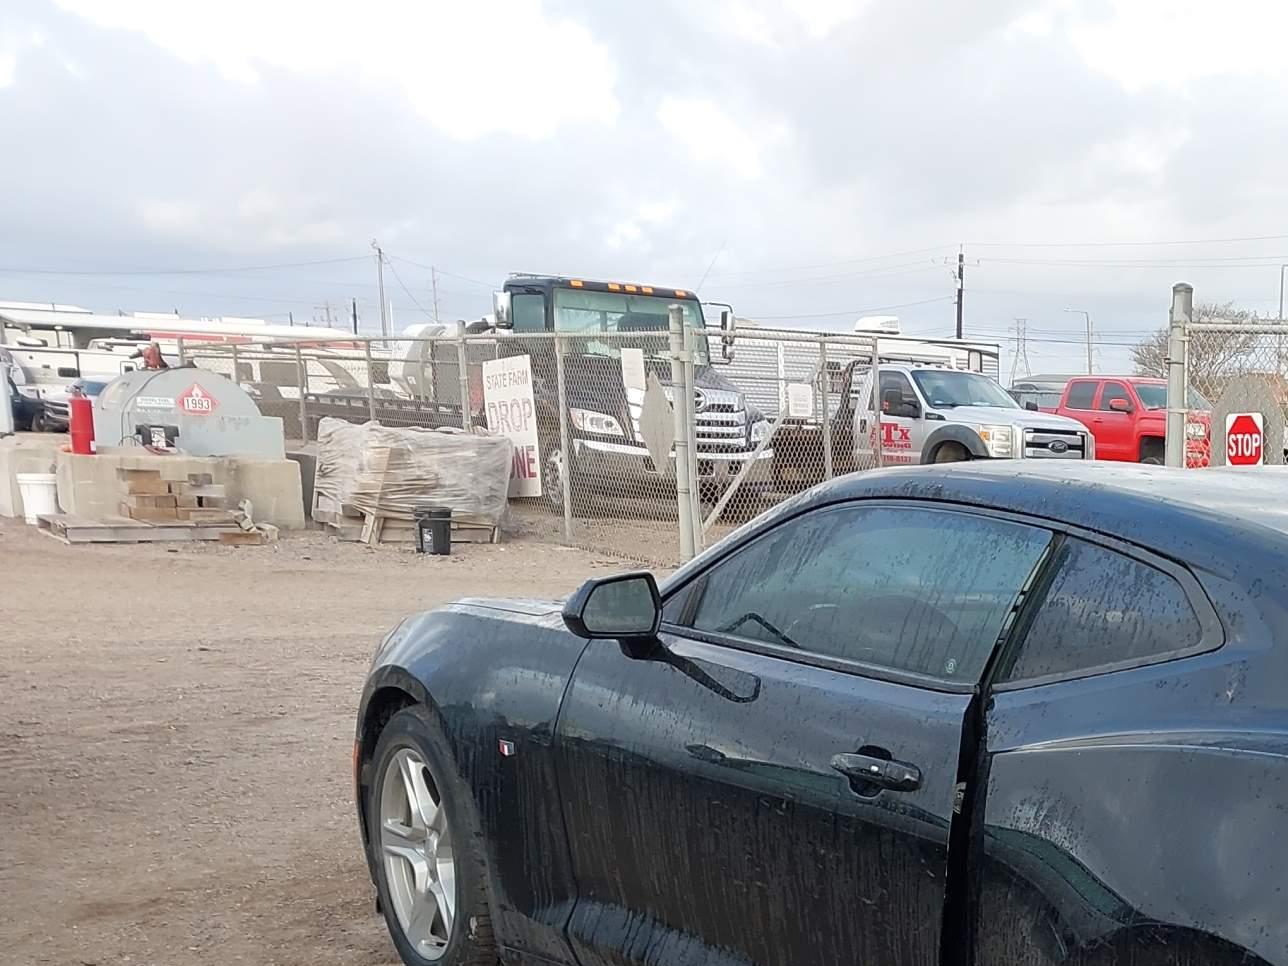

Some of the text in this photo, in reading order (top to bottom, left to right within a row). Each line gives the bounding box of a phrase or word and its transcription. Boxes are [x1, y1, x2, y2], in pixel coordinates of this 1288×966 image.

[486, 368, 529, 390] STATE FARM
[185, 398, 210, 410] 1993
[487, 398, 533, 434] DROP
[1228, 433, 1261, 457] STOP
